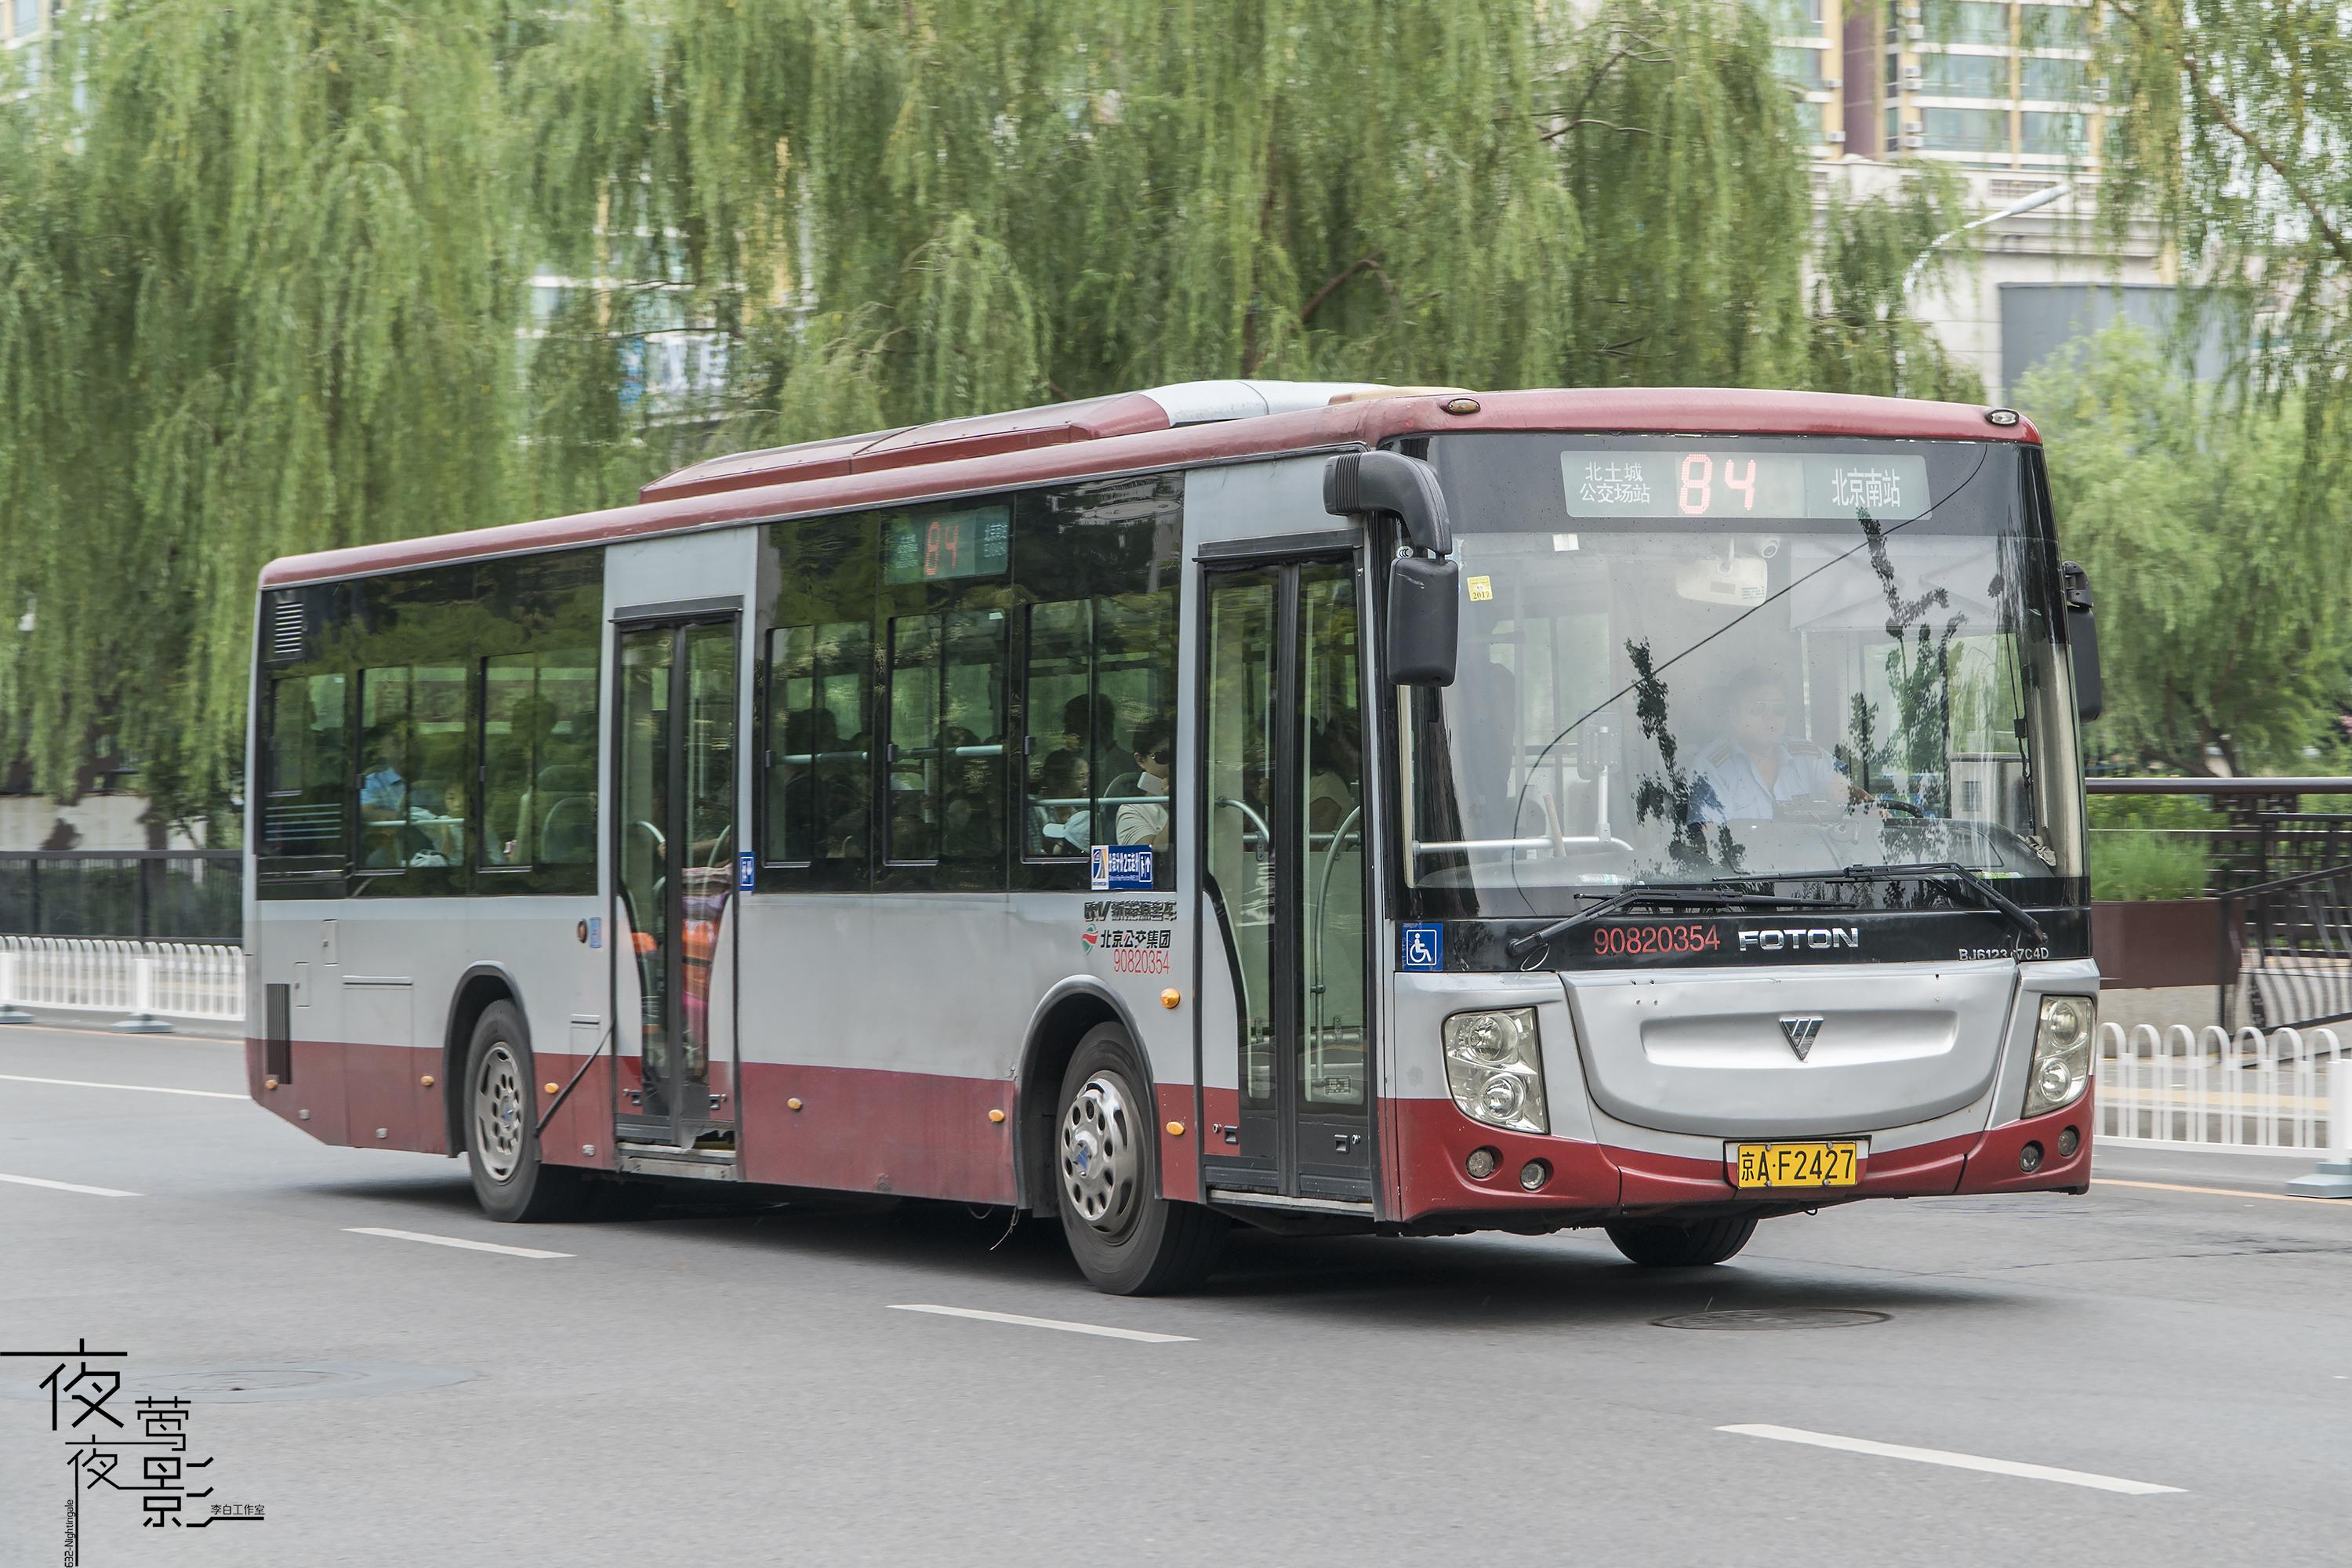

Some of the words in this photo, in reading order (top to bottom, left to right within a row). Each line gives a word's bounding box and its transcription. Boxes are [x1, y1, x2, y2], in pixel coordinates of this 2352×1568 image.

[1585, 461, 1643, 482] 北土城
[1679, 453, 1757, 514] 84
[1579, 483, 1650, 504] 公交场站
[1831, 468, 1901, 508] 北京南站
[924, 521, 960, 576] 84
[1100, 930, 1171, 949] 北京公交集团
[1594, 924, 1720, 955] 90820354
[1738, 927, 1859, 952] FOTON
[1113, 949, 1171, 975] 90820354
